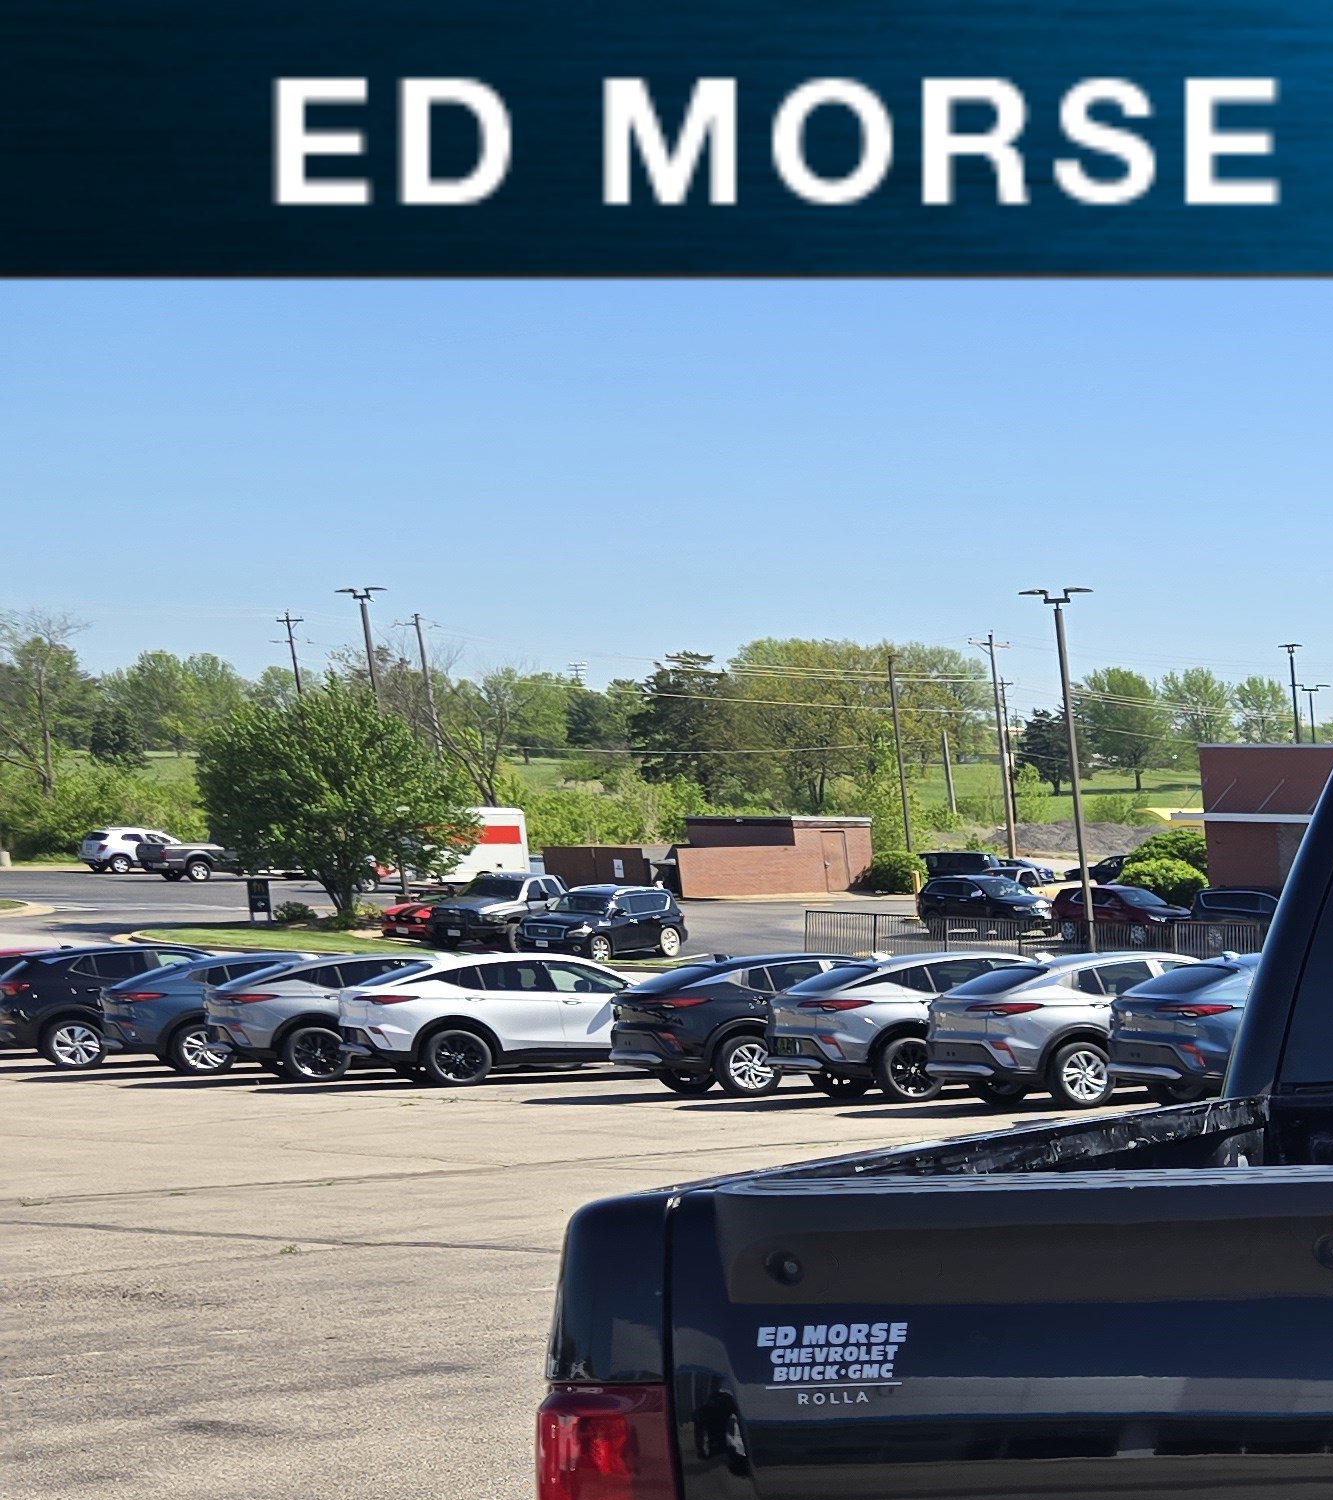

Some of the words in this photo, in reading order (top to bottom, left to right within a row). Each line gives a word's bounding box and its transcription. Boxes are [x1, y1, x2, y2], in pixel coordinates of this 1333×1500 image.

[757, 1325, 798, 1347] ED
[802, 1321, 909, 1346] MORSE
[769, 1344, 900, 1365] CHEVROLET
[797, 1391, 870, 1405] ROLLA
